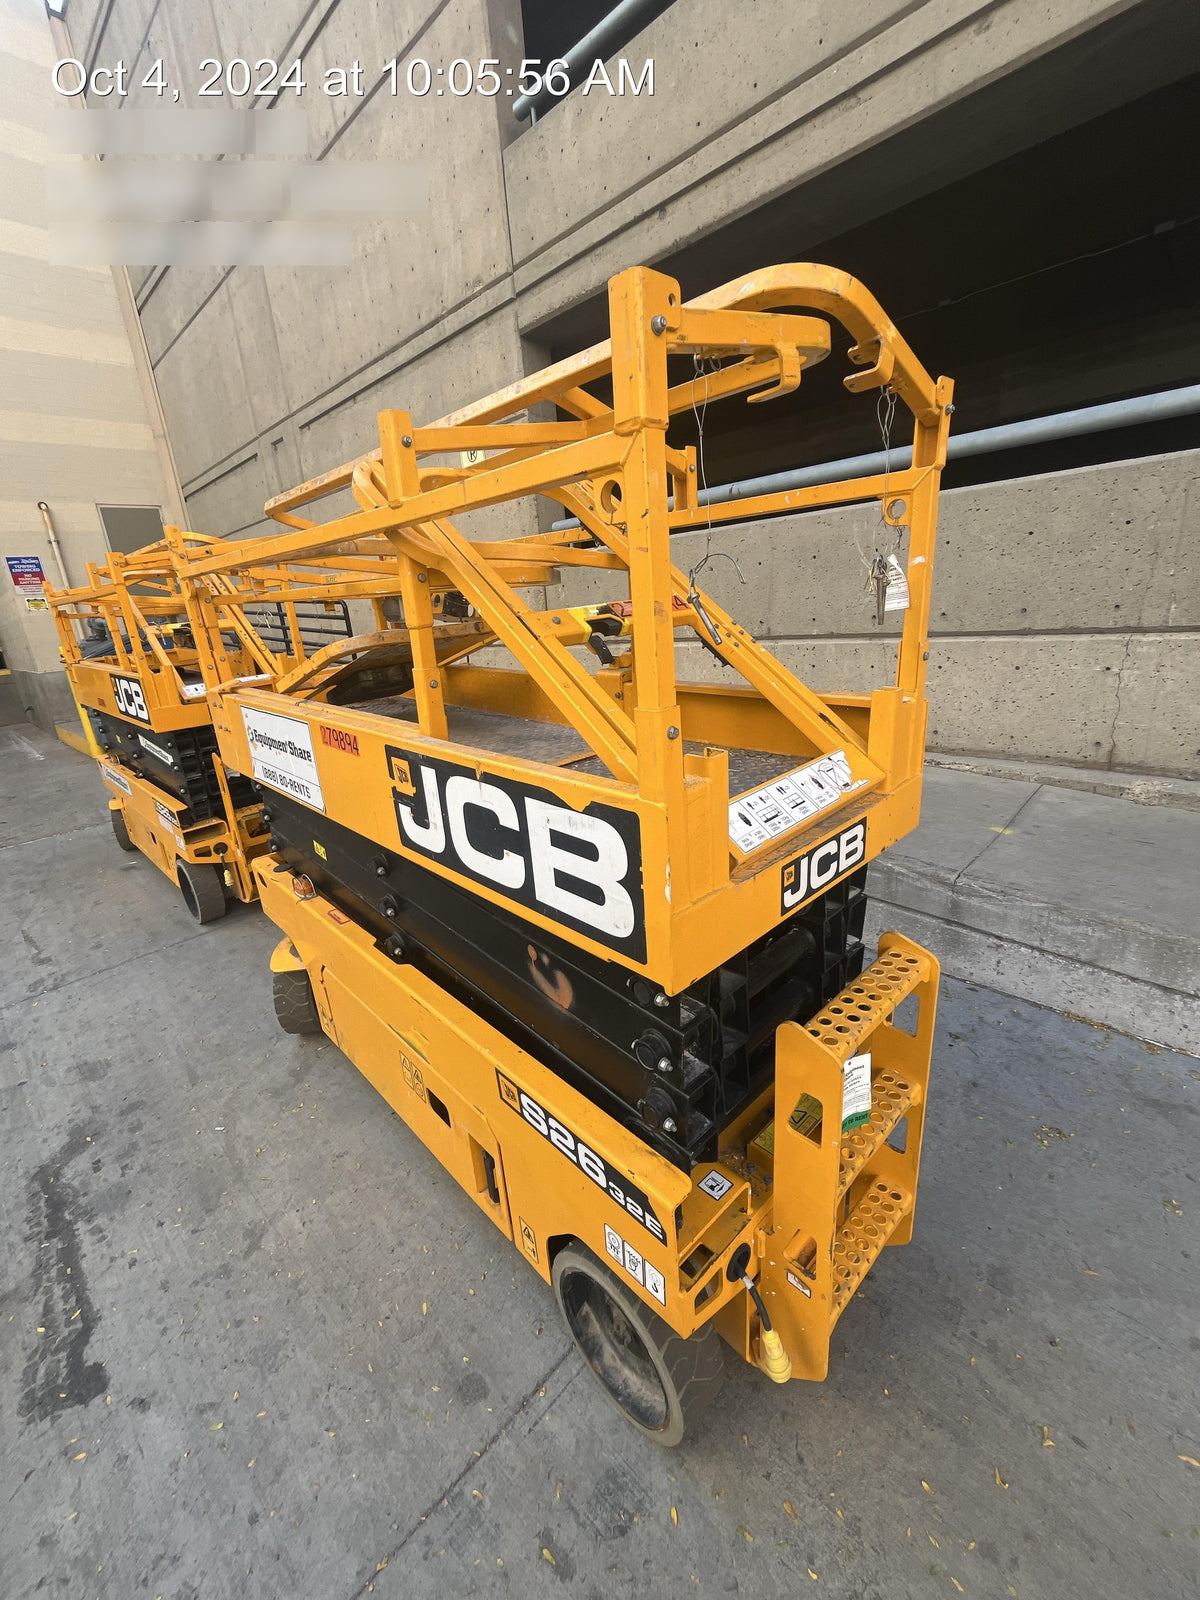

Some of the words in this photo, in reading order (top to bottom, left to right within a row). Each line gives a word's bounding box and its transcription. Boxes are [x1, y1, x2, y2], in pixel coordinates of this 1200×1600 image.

[115, 678, 149, 720] JCB
[262, 765, 278, 785] (888)
[398, 765, 634, 938] JCB
[784, 823, 865, 908] JCB
